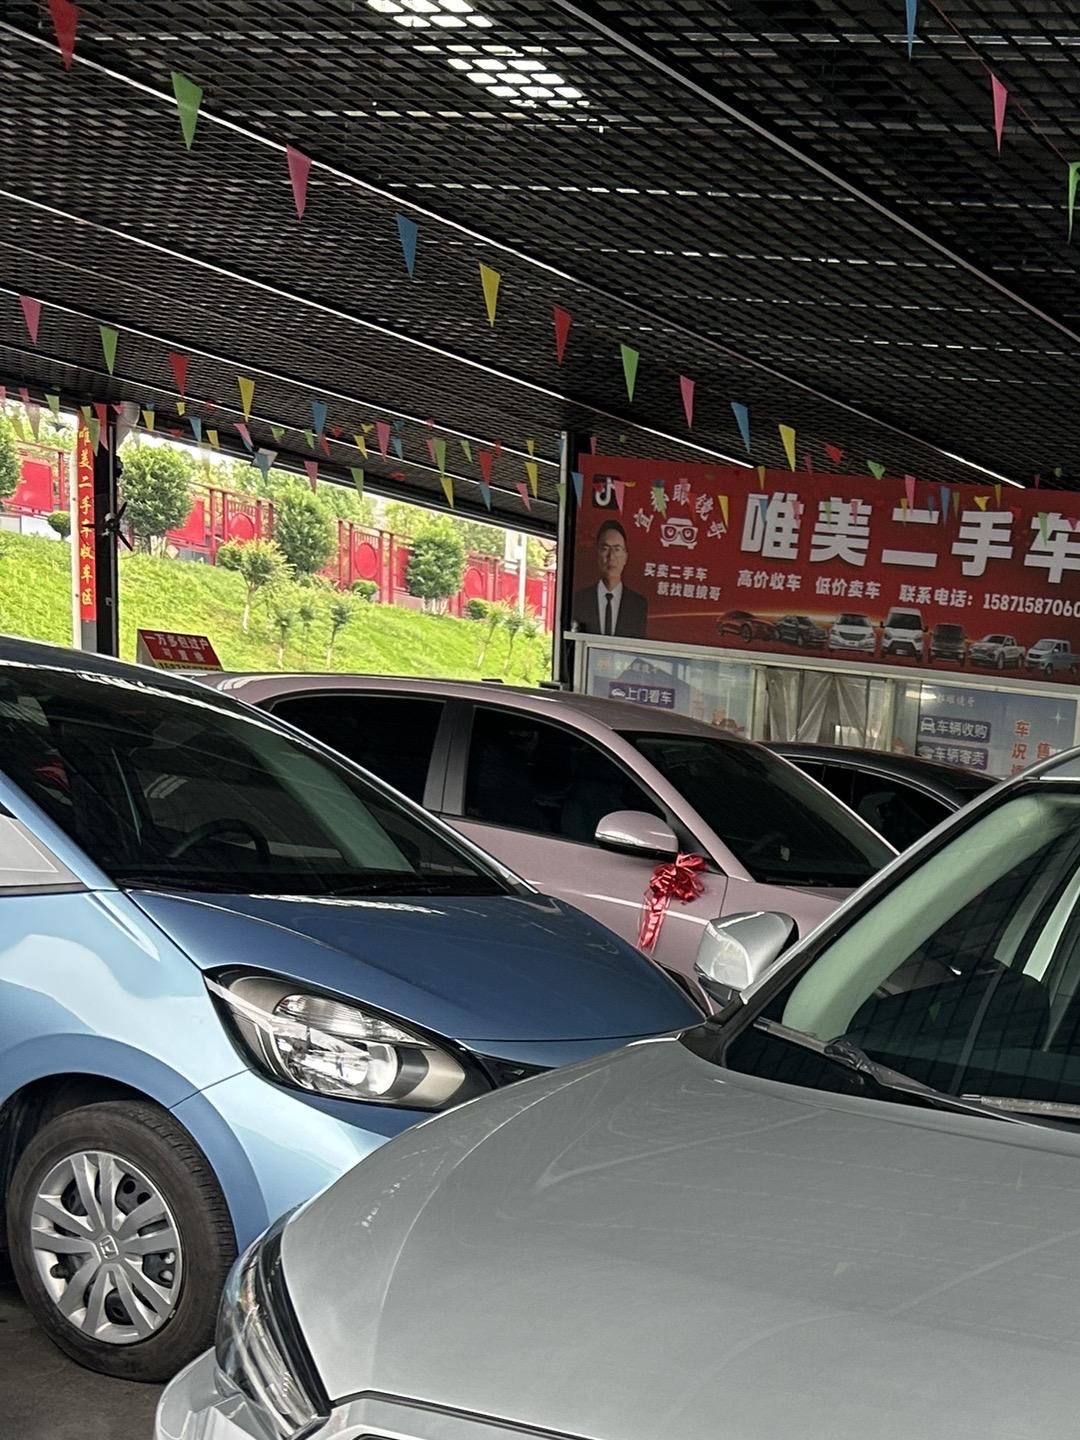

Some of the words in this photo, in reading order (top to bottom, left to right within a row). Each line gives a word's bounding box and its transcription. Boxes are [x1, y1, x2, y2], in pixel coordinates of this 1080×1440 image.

[643, 562, 708, 582] 买卖二手车
[736, 569, 803, 592] 高价收车
[815, 576, 881, 600] 低价卖车
[625, 687, 673, 705] 上门看车
[936, 719, 989, 740] 车辆收购
